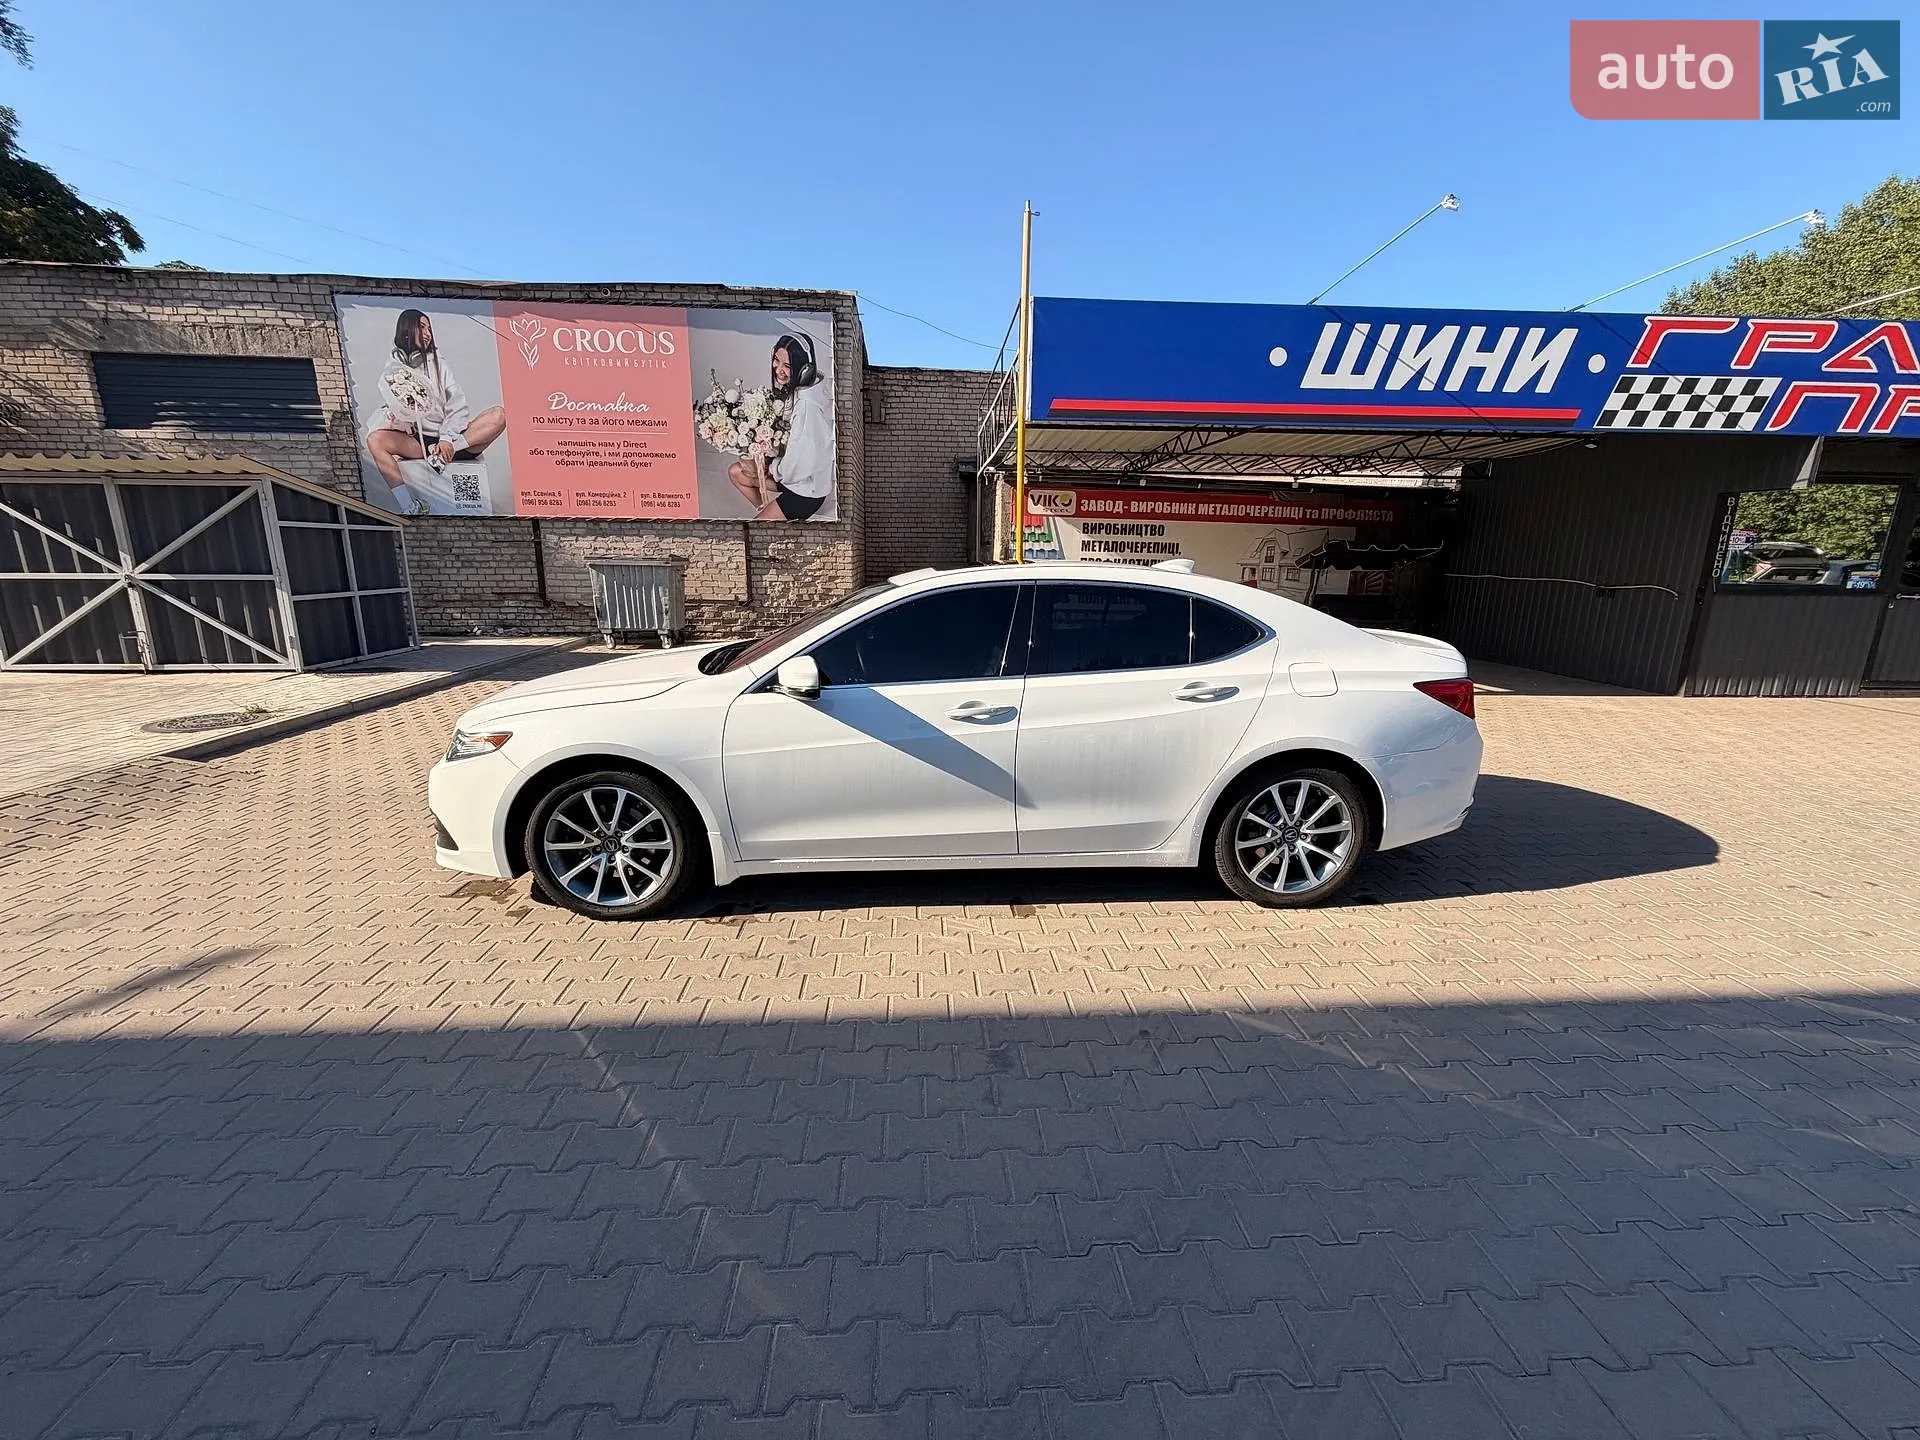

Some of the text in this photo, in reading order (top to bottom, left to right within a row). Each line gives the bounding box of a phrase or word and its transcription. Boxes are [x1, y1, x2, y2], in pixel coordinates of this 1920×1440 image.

[553, 327, 675, 355] CROCUS
[633, 358, 668, 369] БУТІК
[1300, 321, 1579, 394] ШИНИ
[547, 391, 650, 413] Доставка
[532, 415, 668, 427] по місту та за його межами
[557, 439, 597, 448] напишіть
[616, 441, 622, 450] у
[623, 440, 647, 449] Direct
[529, 448, 545, 456] або
[547, 449, 603, 459] телефонуйте,
[622, 452, 677, 460] допоможемо
[555, 459, 653, 469] обрати ідеальний букет
[1131, 501, 1196, 515] ВИРОБНИК
[1198, 503, 1303, 520] МЕТАЛОЧЕРЕПИЦІ
[1305, 508, 1319, 519] та
[1321, 508, 1394, 522] ПРОФЛИСТА
[1082, 522, 1165, 537] ВИРОБНИЦТВО
[1712, 497, 1735, 577] ВІДЧИНЕНО
[1080, 540, 1182, 556] МЕТАЛОЧЕРЕПИЦІ,
